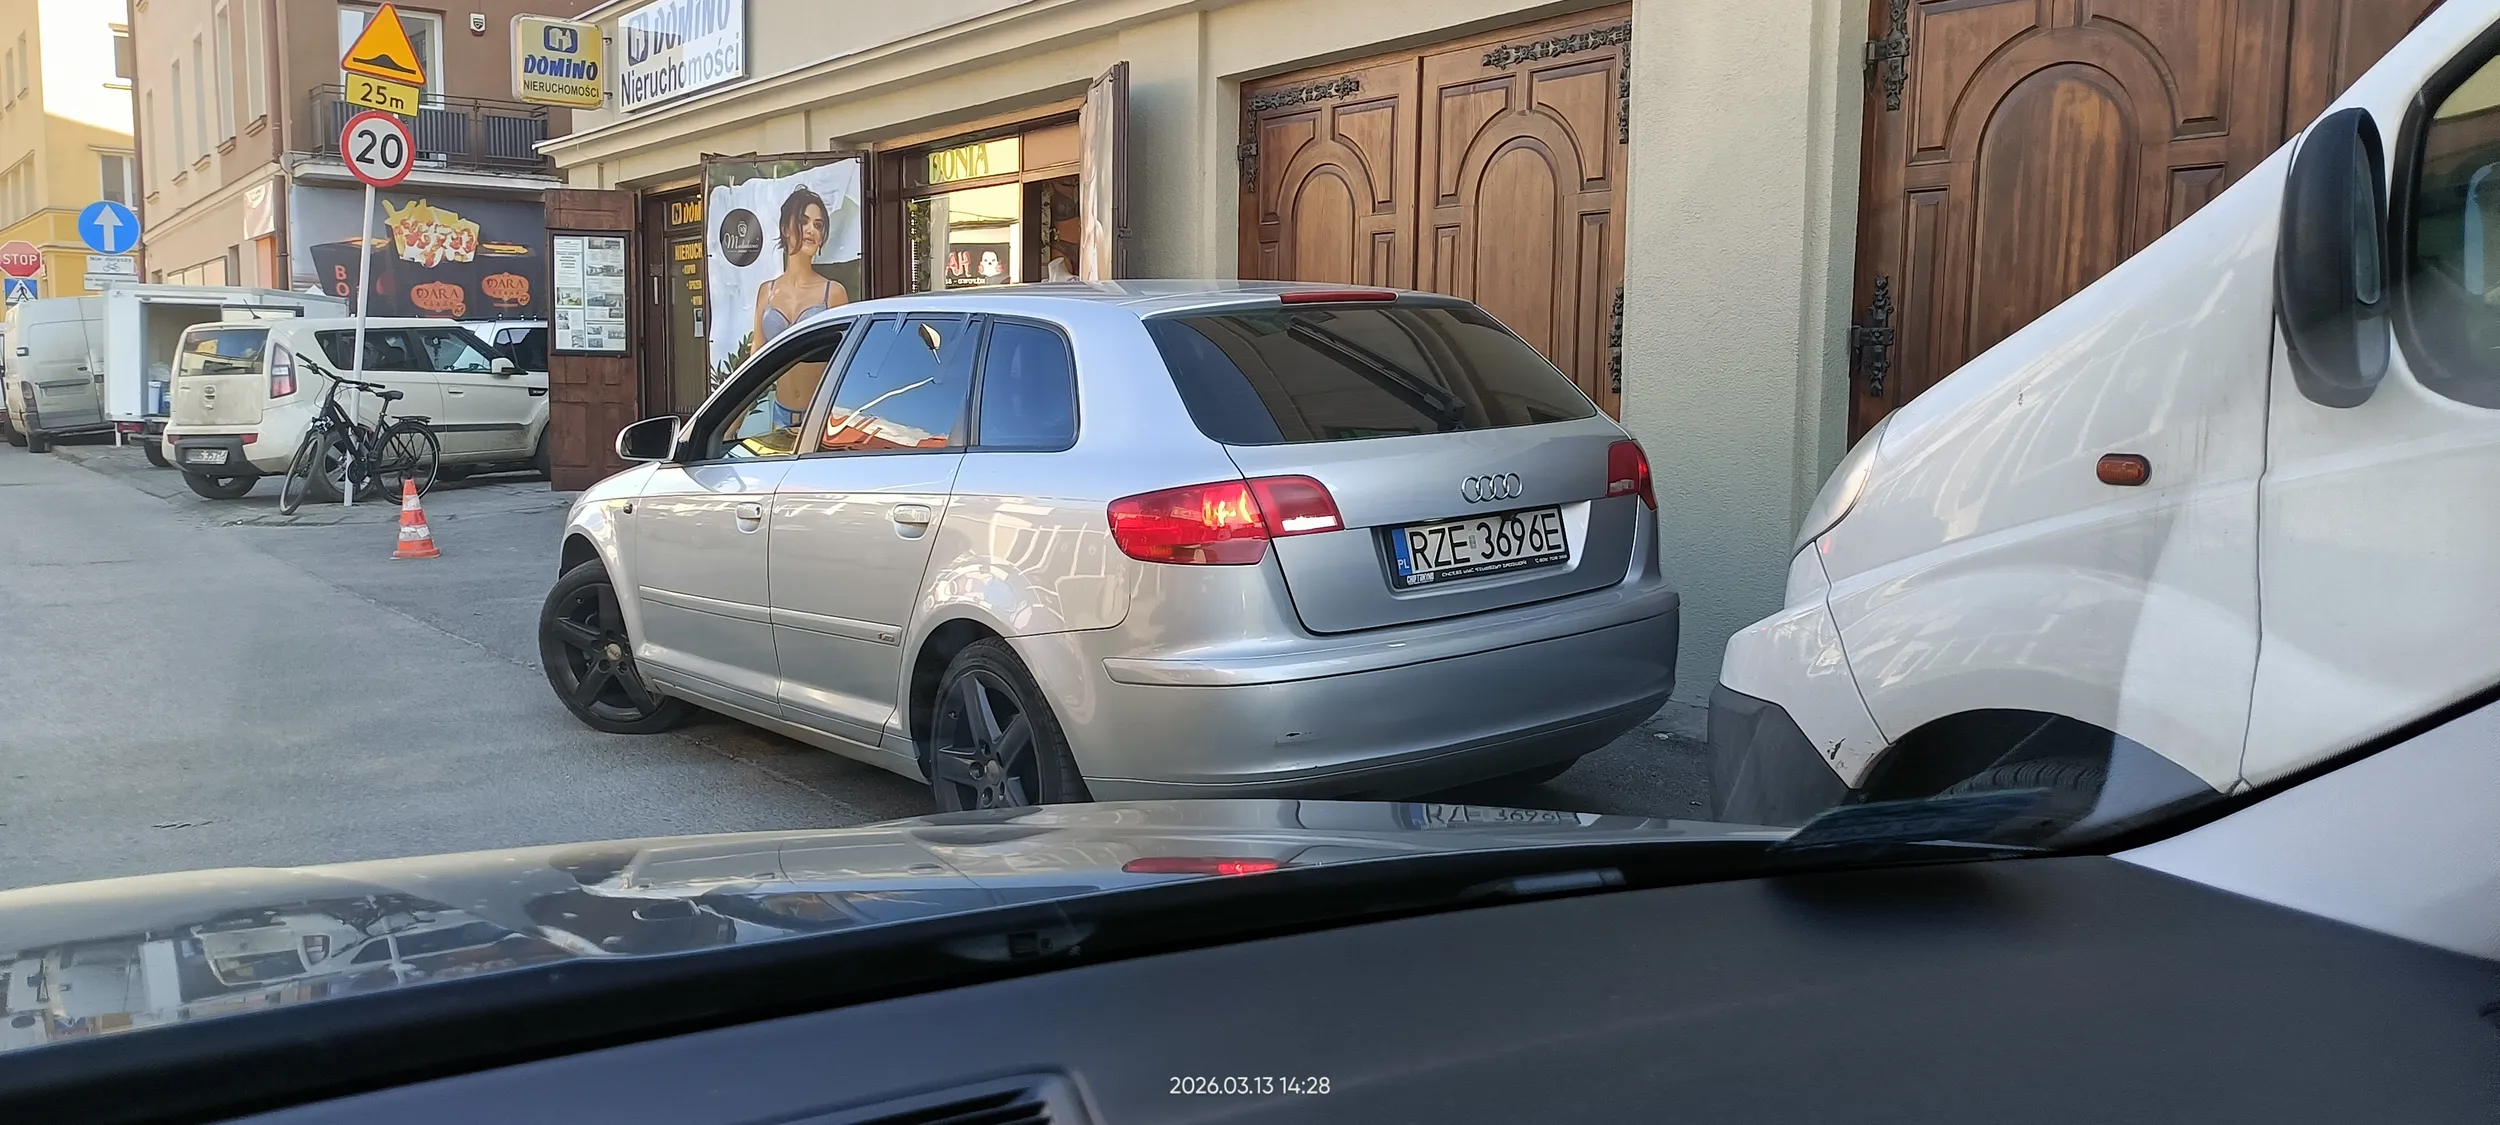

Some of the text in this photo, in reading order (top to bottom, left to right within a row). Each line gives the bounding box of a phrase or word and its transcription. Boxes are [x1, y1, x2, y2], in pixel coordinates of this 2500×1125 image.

[621, 32, 740, 107] Nieruchomości
[523, 79, 600, 98] NIERUCHOMOŚCI
[356, 129, 403, 169] 20
[2, 253, 38, 266] STOP
[416, 288, 459, 299] DARA
[1409, 524, 1470, 571] RZE
[1476, 512, 1562, 560] 3696E
[1397, 559, 1410, 570] PL
